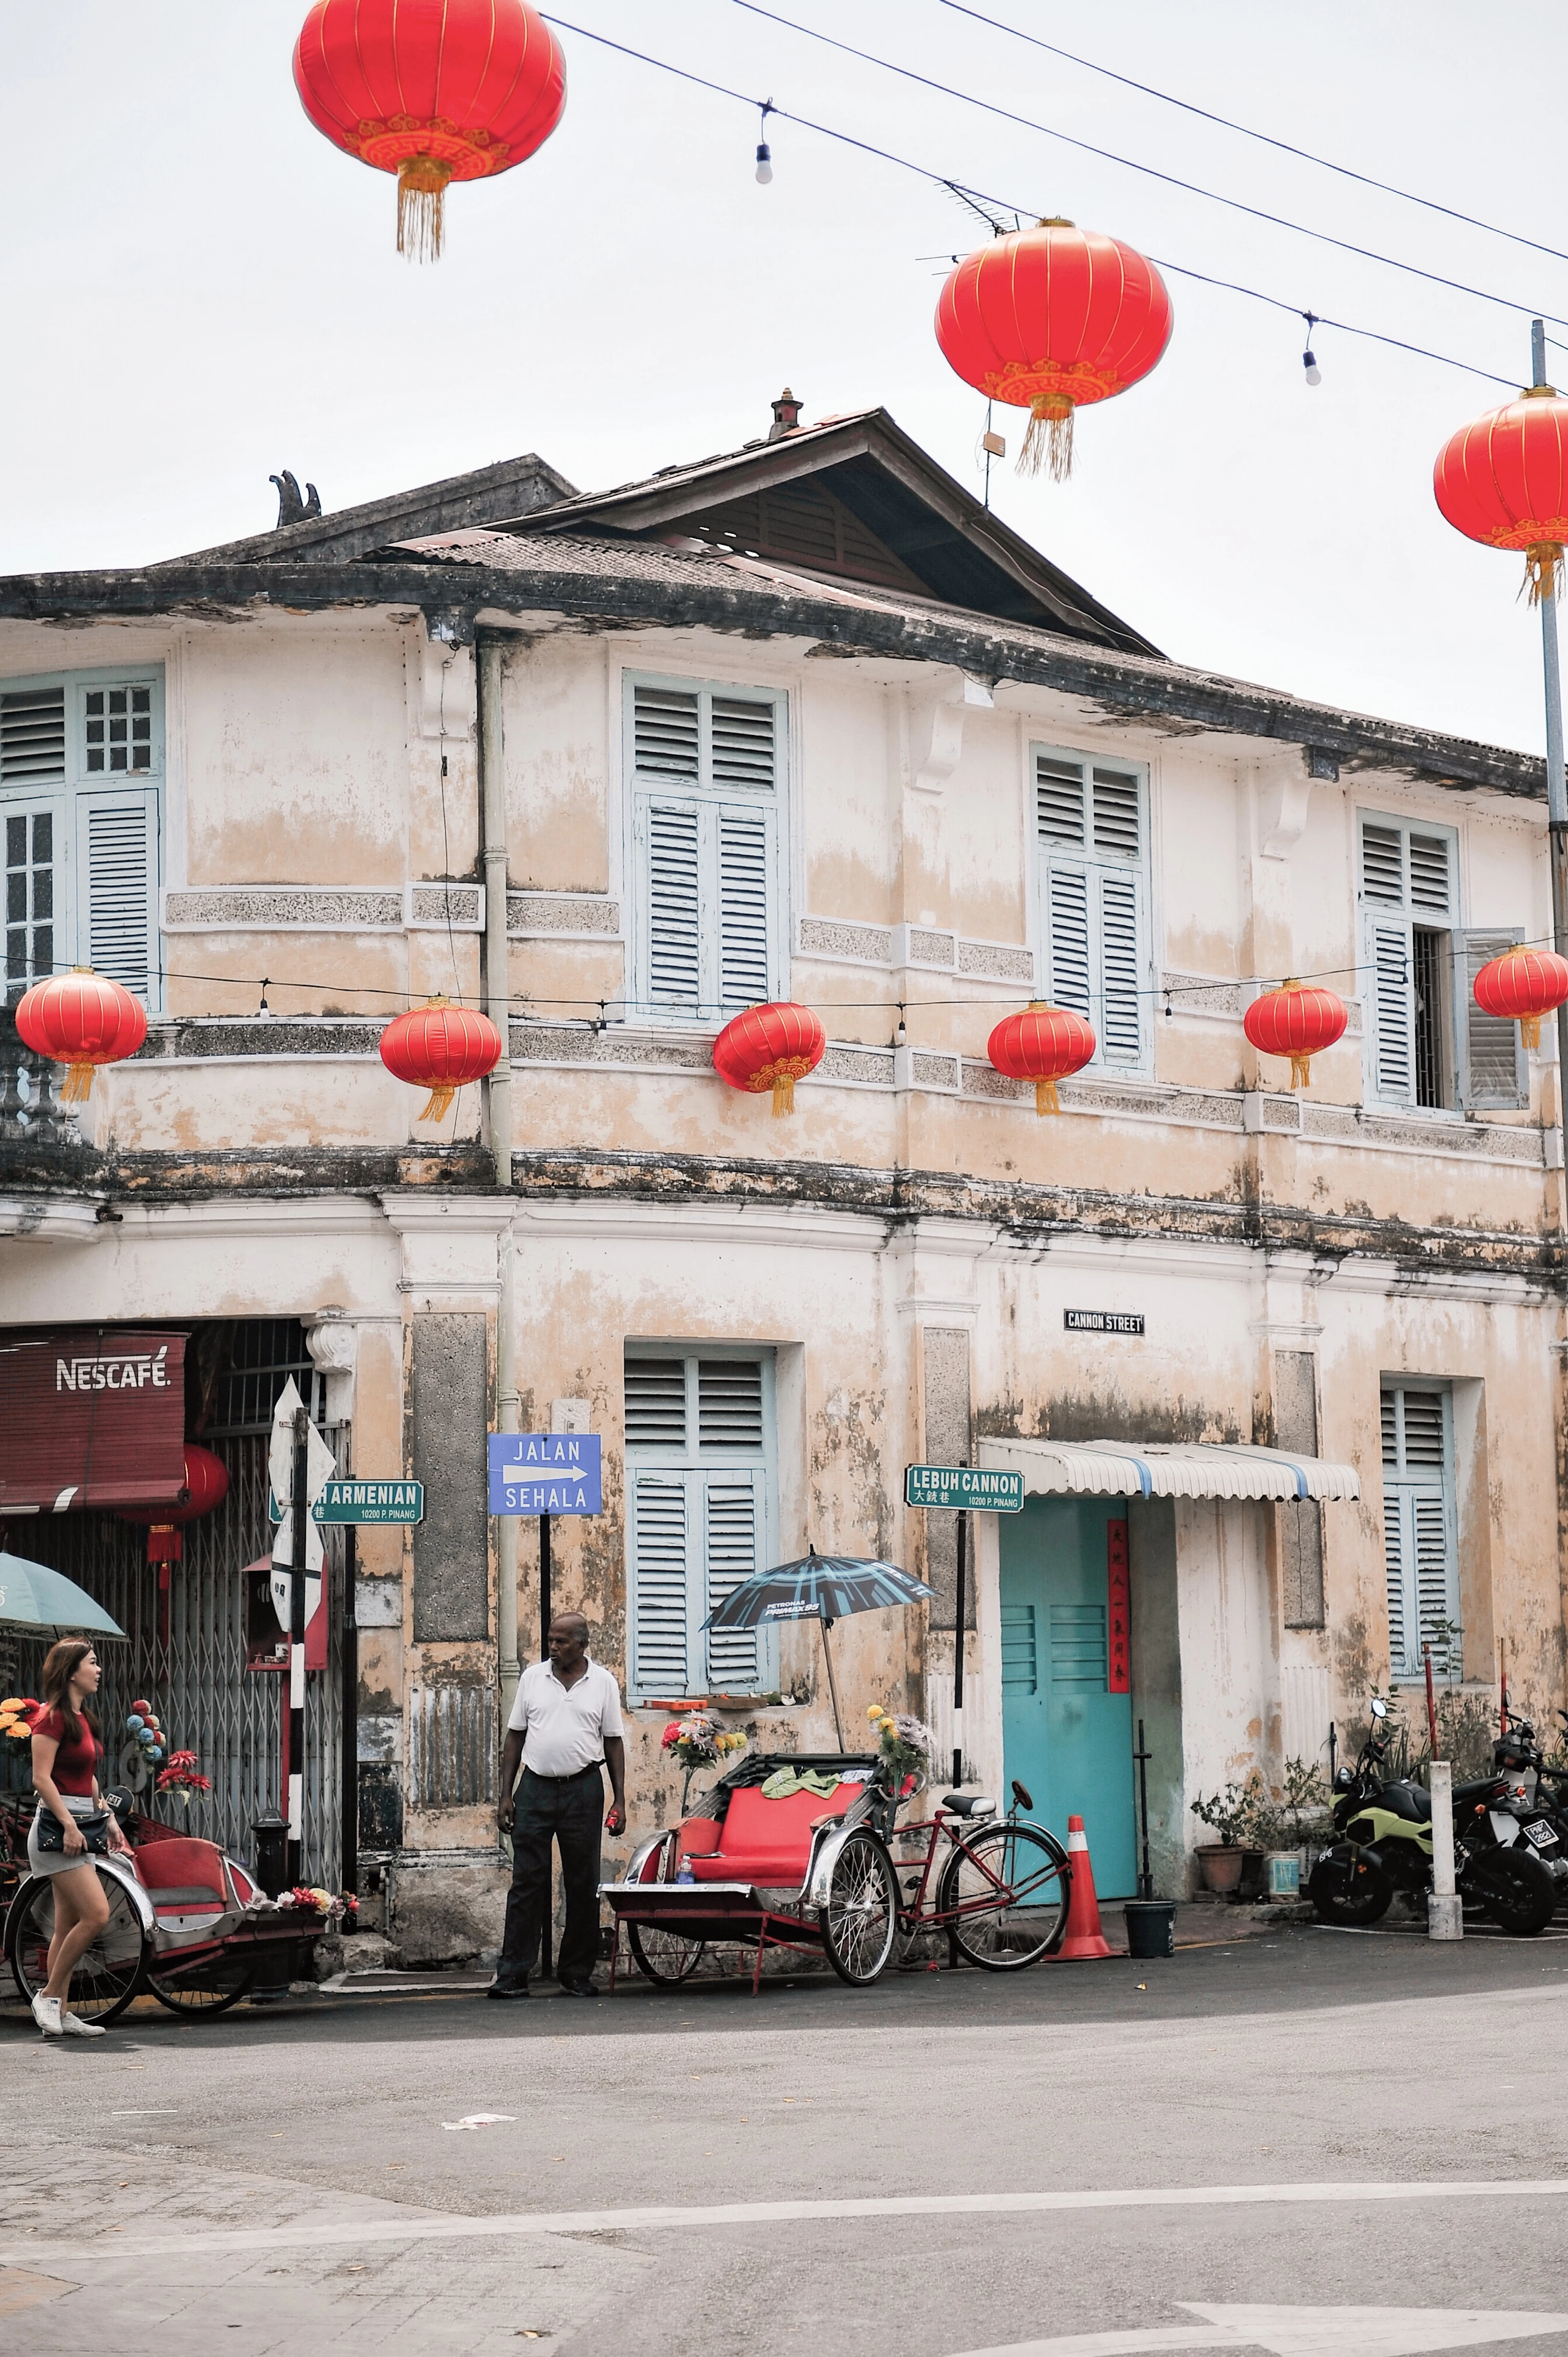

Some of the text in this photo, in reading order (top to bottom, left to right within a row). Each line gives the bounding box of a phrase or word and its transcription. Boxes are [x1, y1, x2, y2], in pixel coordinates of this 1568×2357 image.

[1068, 1312, 1141, 1332] CANNON STREET
[513, 1441, 579, 1461] JALAN
[913, 1470, 1018, 1494] LEBUH CANNON
[331, 1486, 416, 1504] ARMENIAN
[506, 1488, 586, 1508] SEHALA
[969, 1496, 1018, 1507] 10200 P. PINANG
[361, 1510, 415, 1519] 10200 P. PINANG
[767, 1600, 805, 1609] PETRONAS
[107, 1795, 120, 1805] CAT
